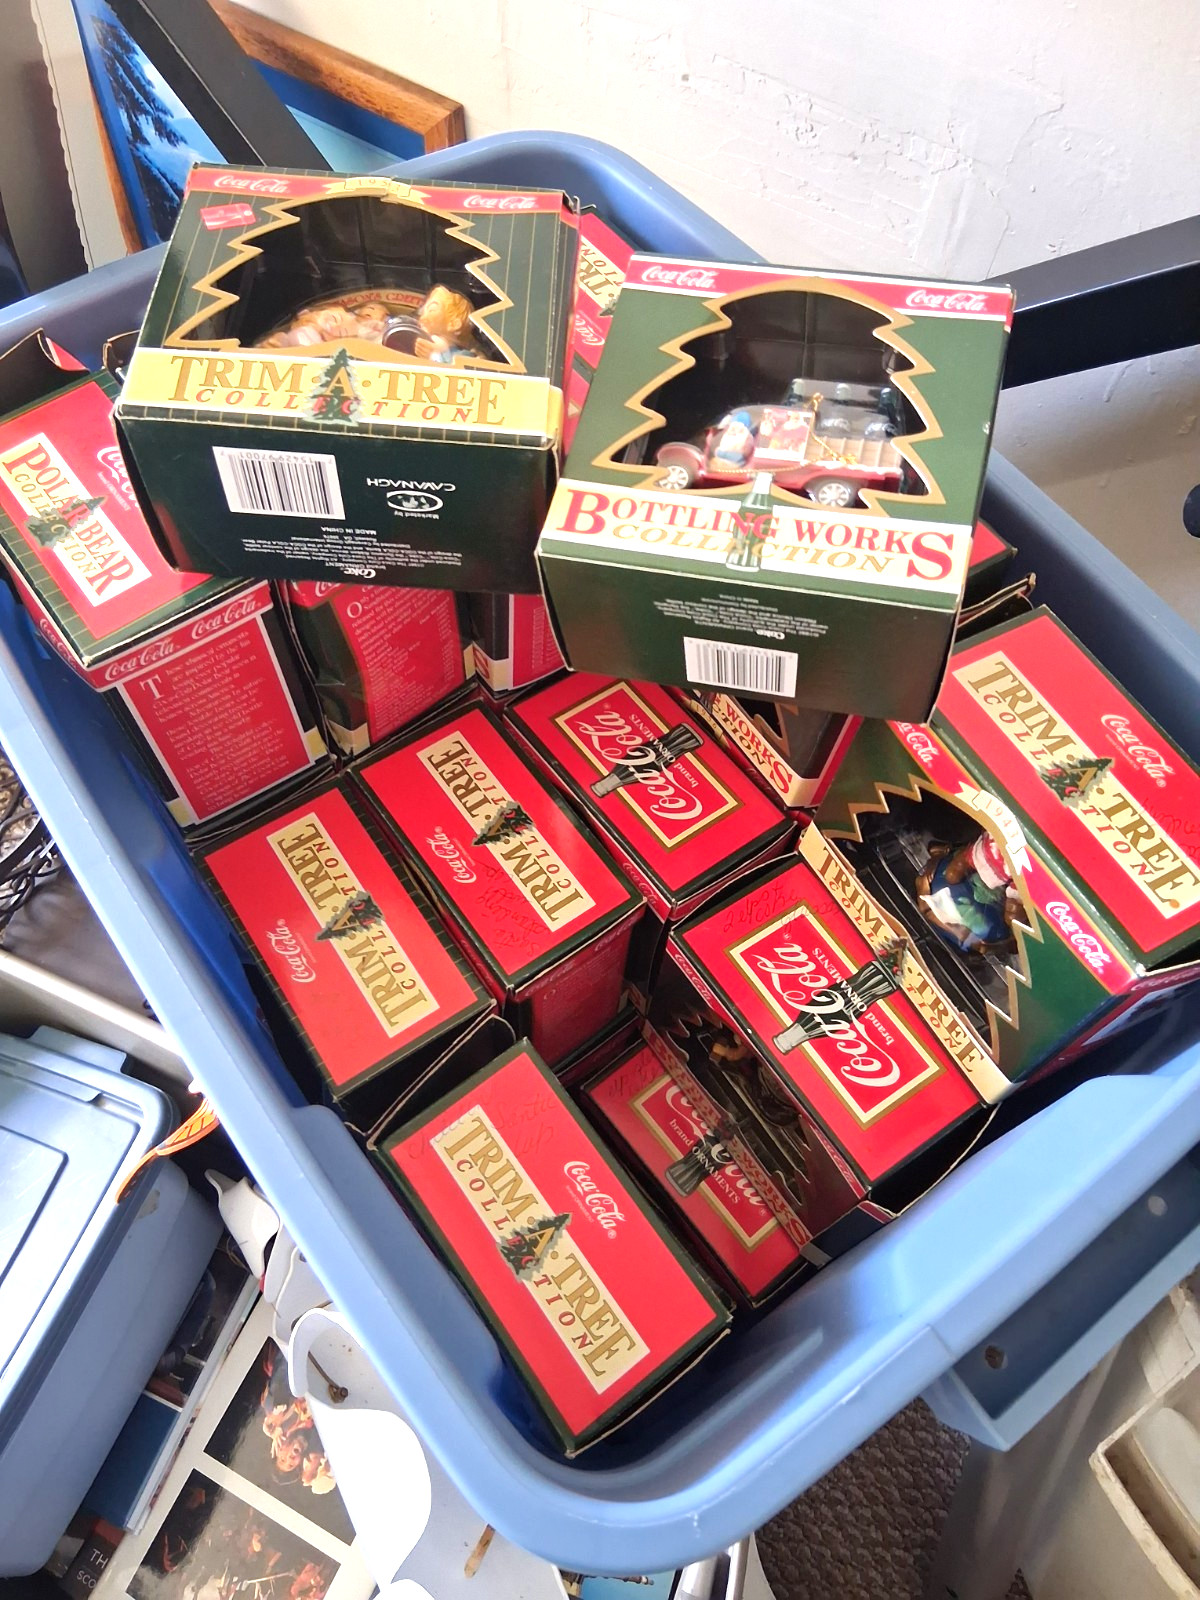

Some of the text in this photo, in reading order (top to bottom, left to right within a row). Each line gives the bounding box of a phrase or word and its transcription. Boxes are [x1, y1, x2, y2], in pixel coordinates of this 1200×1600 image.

[214, 175, 289, 194] Coca-Cola
[463, 194, 537, 210] Coca-Cola
[641, 265, 716, 289] Coca-Cola
[906, 289, 986, 313] Coca-Cola
[168, 356, 507, 426] TRIM A TREE
[195, 388, 474, 424] COLLECTION
[2, 442, 135, 597] POLAR BEAR
[14, 473, 98, 574] COLLECTION
[366, 477, 456, 492] CAVANAGH
[343, 567, 377, 579] Coke
[556, 489, 955, 581] BOTTLING WORKS
[612, 524, 895, 573] COLLECTION
[105, 594, 256, 682] Coca-Cola Coca-Cola
[427, 740, 492, 819] TREE
[575, 711, 703, 821] Coca-Cola
[628, 713, 700, 788] brand ORNAMENTS
[726, 700, 793, 794] WORKS
[899, 721, 939, 764] a-Cola
[967, 661, 1077, 756] TRIM
[1099, 792, 1200, 903] TREE
[1100, 714, 1177, 782] Coca-Cola
[983, 693, 1155, 877] COLLECTION
[277, 823, 342, 911] TREE
[426, 832, 477, 884] Coca-Cola
[500, 841, 584, 922] TRIM
[266, 925, 317, 983] Coca-Cola
[817, 845, 886, 936] TRIM
[908, 971, 985, 1073] TREE
[1045, 901, 1111, 968] Coca-Cola
[344, 936, 428, 1028] TRIM
[752, 943, 901, 1088] Coca-Cola
[811, 946, 895, 1046] brand ORNAMENTS
[564, 1160, 626, 1231] Coca-Cola
[669, 1118, 694, 1147] brand
[691, 1145, 741, 1205] ORNAMENTS
[444, 1116, 539, 1223] TRIM
[524, 1226, 556, 1259] A
[551, 1253, 636, 1377] TREE
[457, 1158, 594, 1350] COLLECTION
